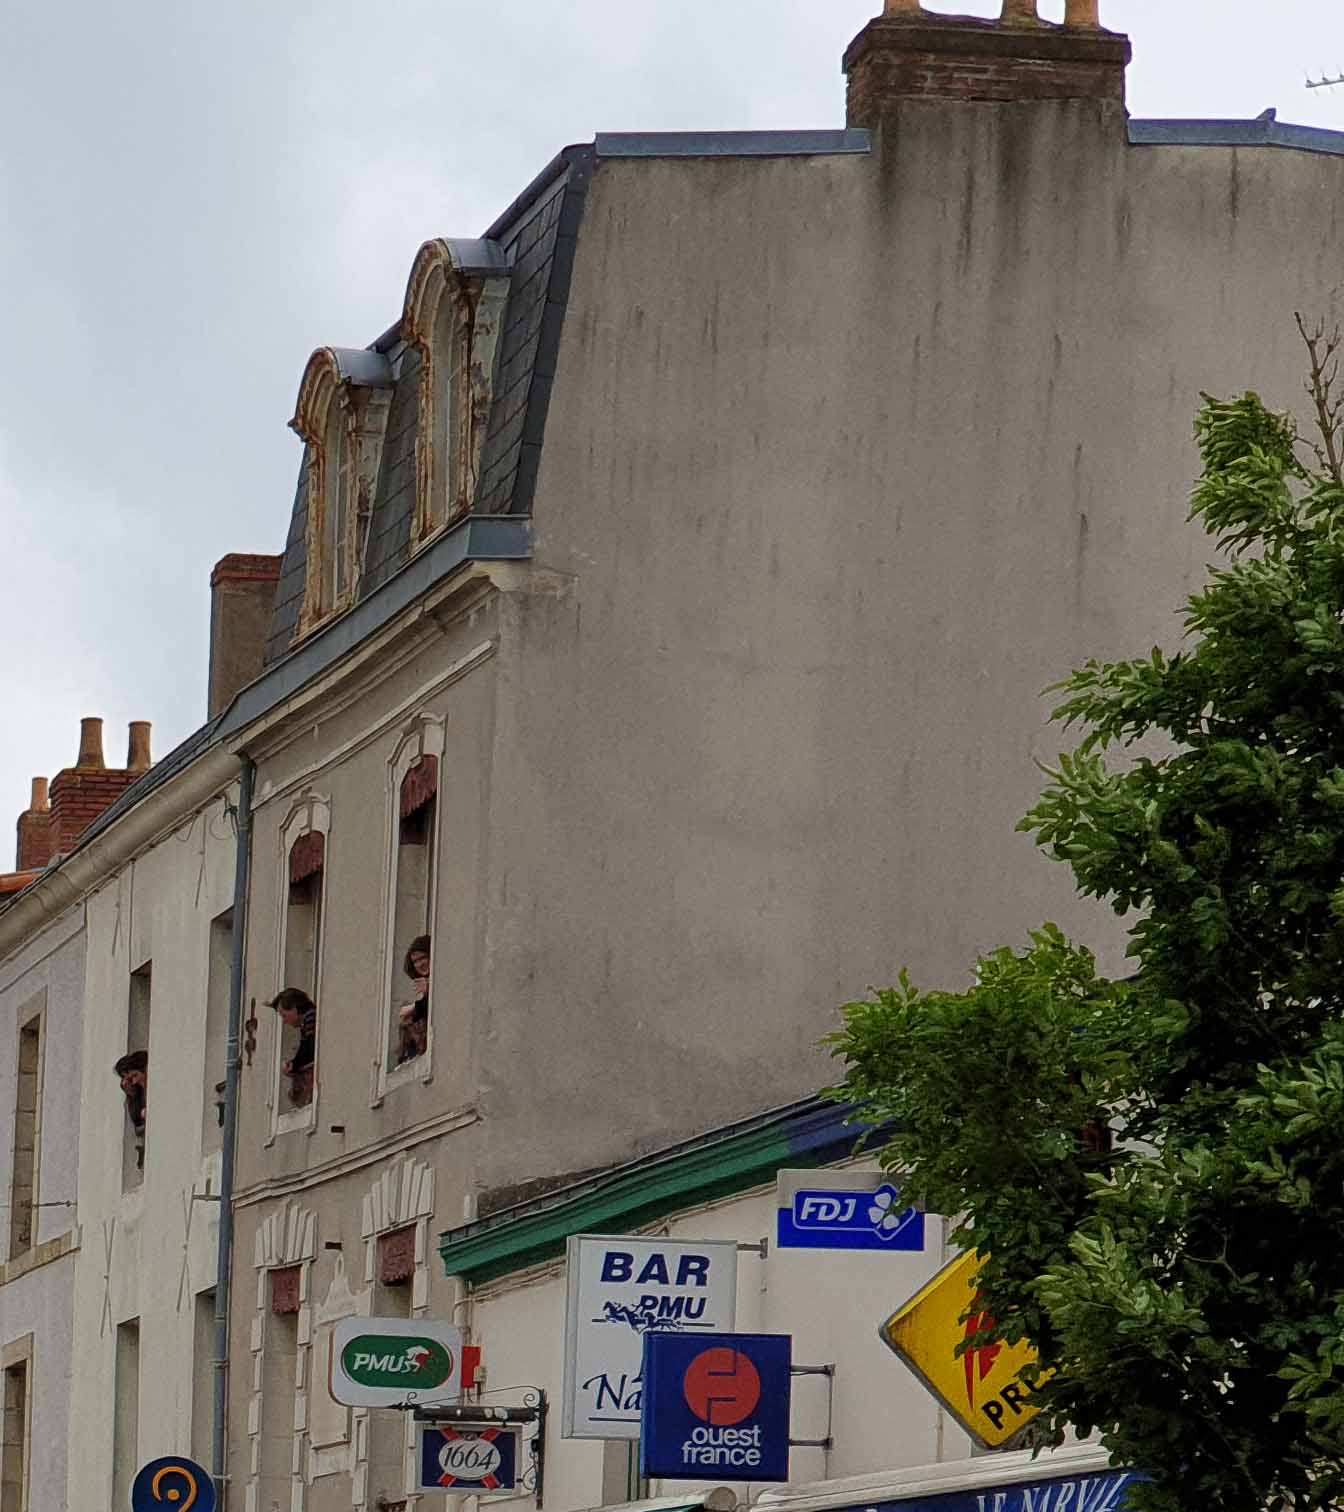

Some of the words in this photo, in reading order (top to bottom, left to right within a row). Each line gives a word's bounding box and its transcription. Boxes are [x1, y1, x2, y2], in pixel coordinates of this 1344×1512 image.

[800, 1197, 857, 1222] FDJ
[600, 1251, 710, 1287] BAR
[638, 1294, 706, 1320] PMU
[353, 1353, 404, 1373] PMU
[692, 1425, 761, 1447] ouest
[444, 1444, 498, 1470] 1664
[681, 1441, 761, 1466] france
